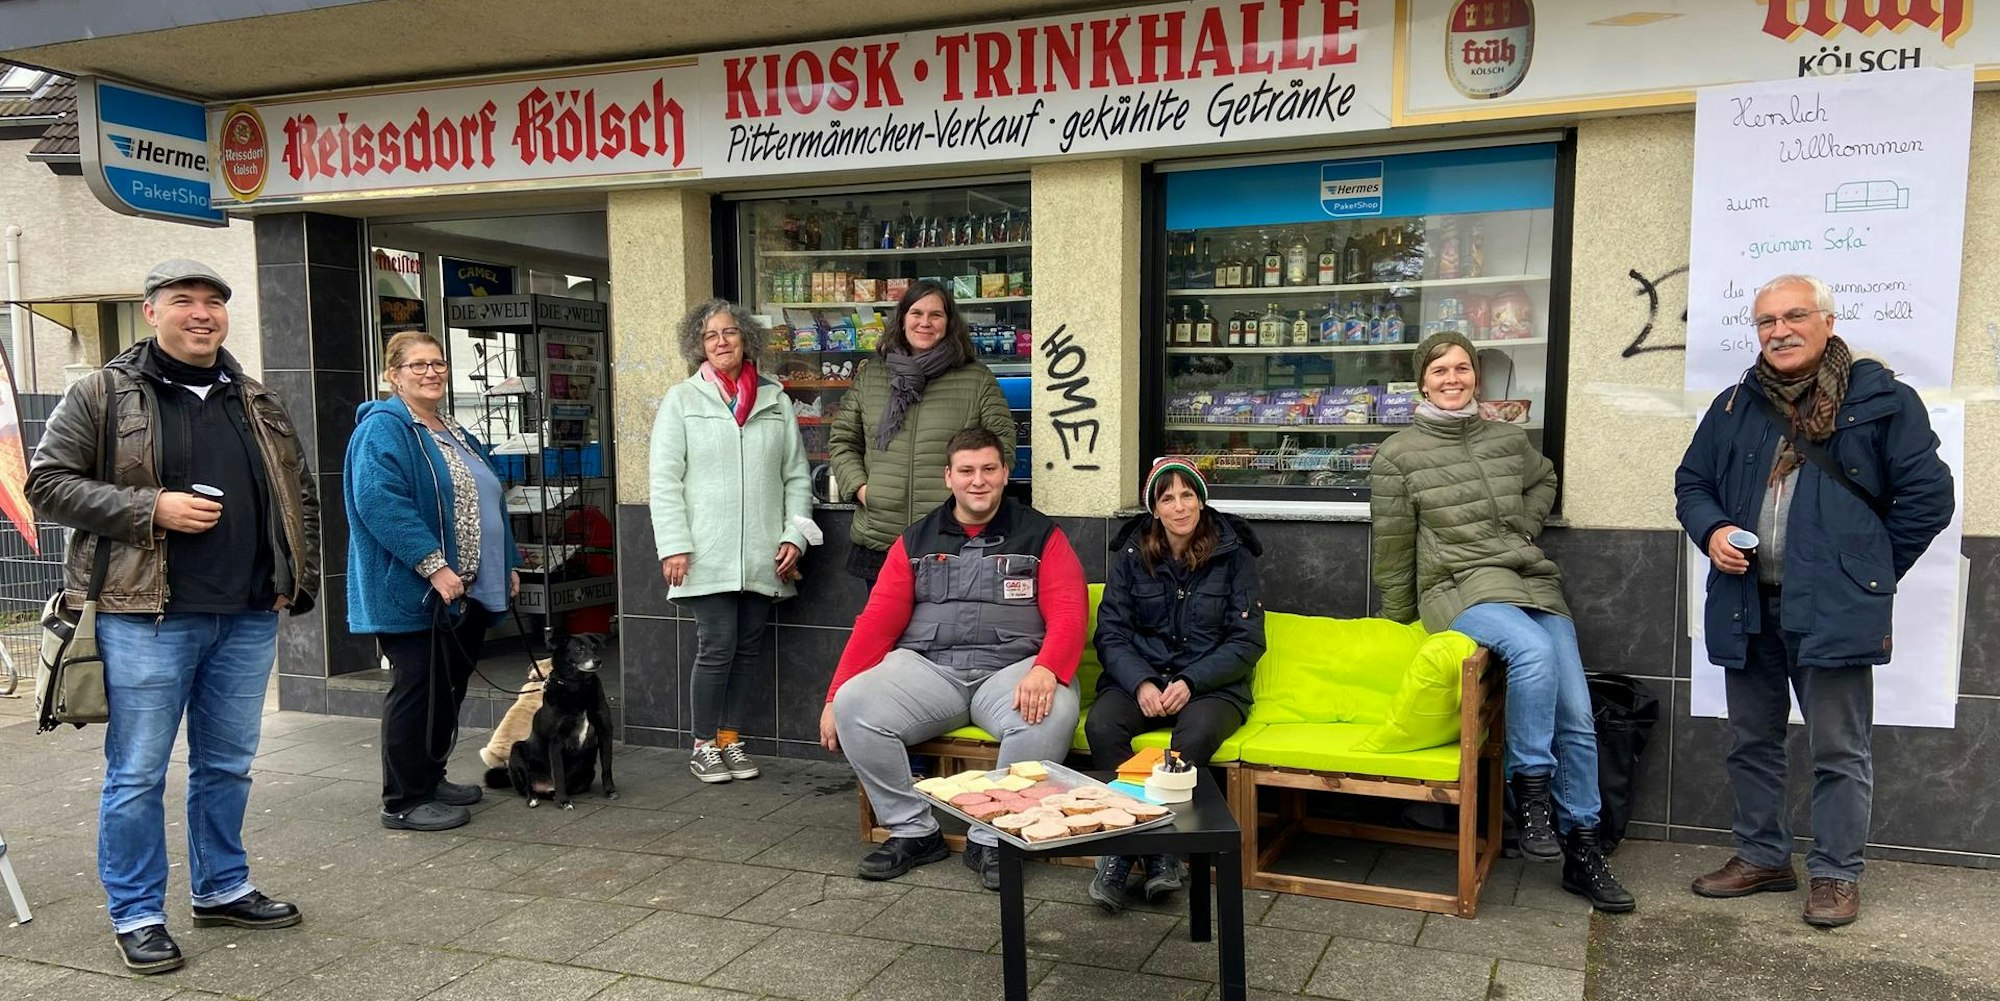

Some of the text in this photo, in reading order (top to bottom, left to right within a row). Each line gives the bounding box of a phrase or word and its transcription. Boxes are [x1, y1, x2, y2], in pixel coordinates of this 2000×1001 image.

[724, 0, 1358, 119] KIOSK TRINKHALLE
[1461, 37, 1516, 66] früh
[1798, 46, 1921, 77] KÖLSCH
[727, 73, 1356, 163] Pittermännchen-Verkauf gekühlte Getränke
[1731, 92, 1829, 128] Herzlich
[282, 77, 684, 182] Reissdorf Kölsch
[1779, 133, 1924, 163] Willkommen
[132, 180, 208, 206] PaketSho
[1337, 184, 1379, 194] Hermes
[1334, 202, 1378, 210] PaketShop
[1727, 196, 1770, 211] zum
[458, 265, 499, 284] CAMEL
[1723, 279, 1745, 299] die
[451, 302, 529, 321] DIE WELT
[1873, 300, 1915, 321] stellt
[1720, 333, 1754, 353] sich
[519, 591, 543, 607] ELT
[584, 582, 613, 600] WELT
